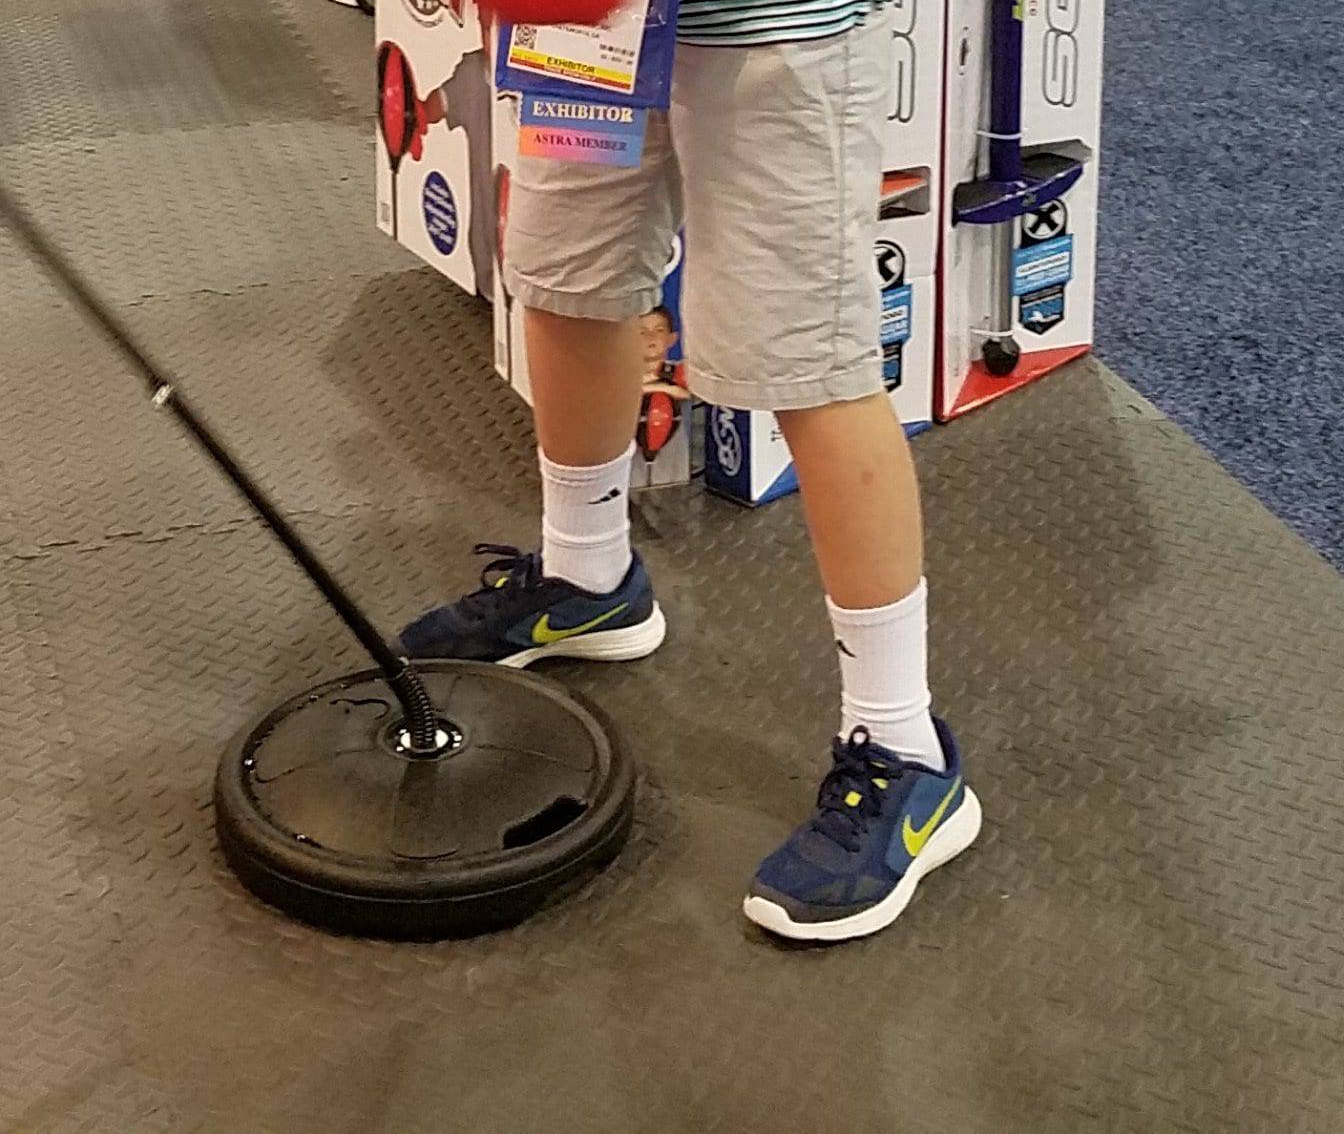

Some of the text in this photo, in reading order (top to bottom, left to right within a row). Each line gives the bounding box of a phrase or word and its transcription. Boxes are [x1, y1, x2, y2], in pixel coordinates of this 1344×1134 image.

[546, 55, 596, 74] EXHIBITOR
[532, 100, 634, 124] EXHIBITOR
[533, 133, 628, 152] ASTRA MEMBER
